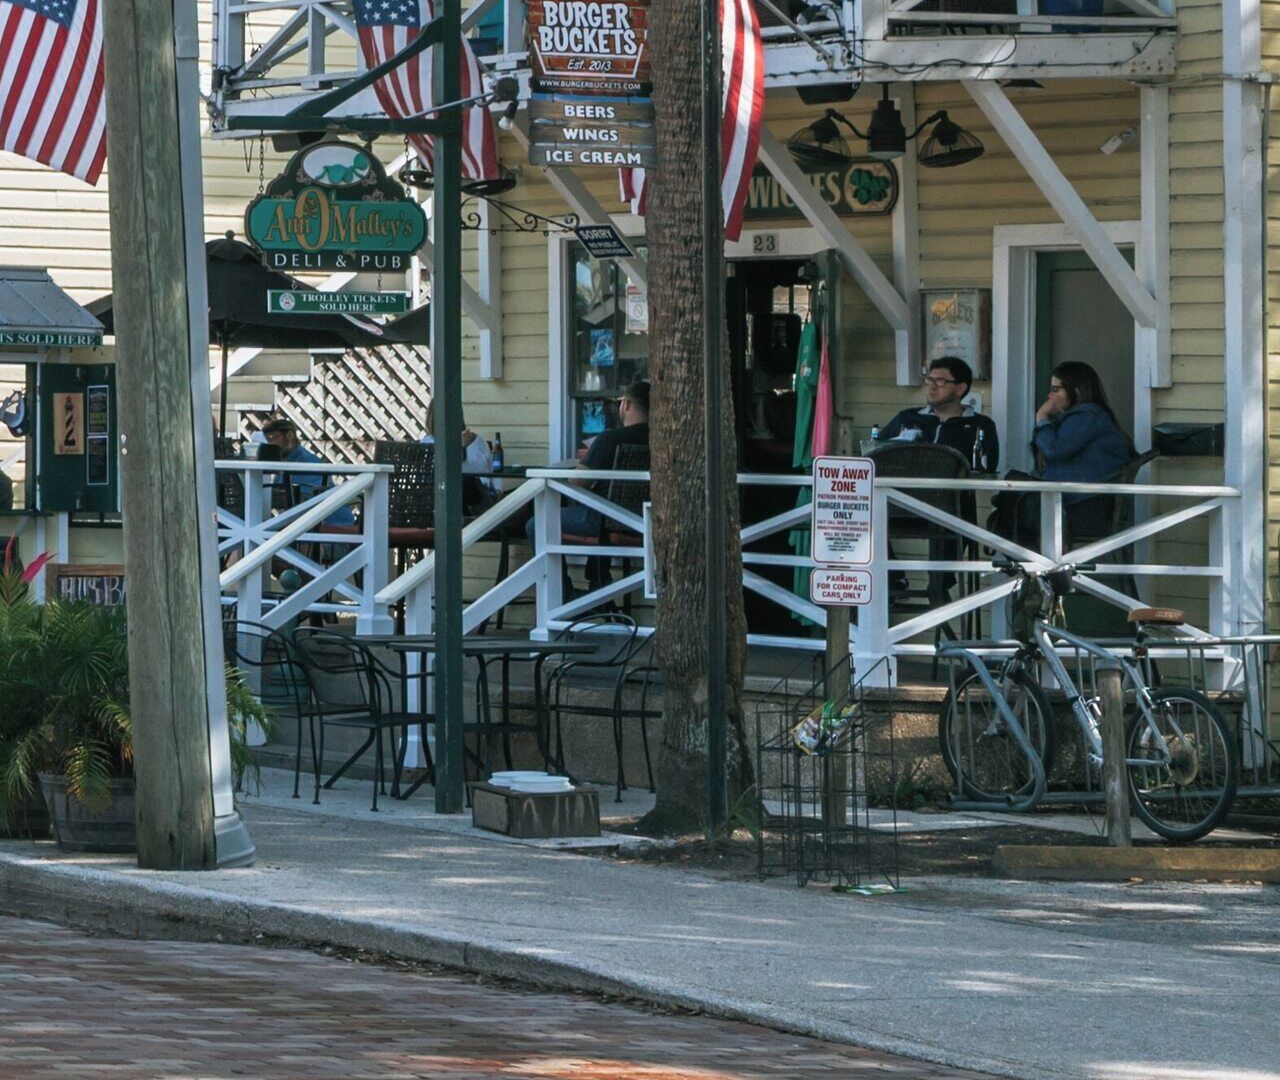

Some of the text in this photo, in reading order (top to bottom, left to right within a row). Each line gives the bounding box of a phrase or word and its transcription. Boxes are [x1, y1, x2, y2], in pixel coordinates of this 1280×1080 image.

[543, 0, 630, 29] BURGER
[538, 25, 637, 55] BUCKETS
[567, 59, 612, 71] Est. 2013
[539, 79, 641, 90] WWW.BURGERBUCKETS.COM
[564, 104, 616, 119] BEERS
[562, 128, 619, 141] WINGS
[545, 150, 642, 164] ICE CREAM
[579, 229, 613, 240] SORRY
[753, 235, 776, 252] 23
[275, 253, 401, 268] DELI & PUB
[301, 294, 397, 303] TROLLEY TICKETS
[17, 334, 55, 344] SOLD
[58, 334, 96, 345] HERE
[818, 467, 870, 480] TOW AWAY
[830, 481, 856, 493] ZONE
[817, 501, 870, 511] BURGER BUCKETS
[833, 511, 853, 519] ONLY
[842, 591, 861, 599] ONLY
